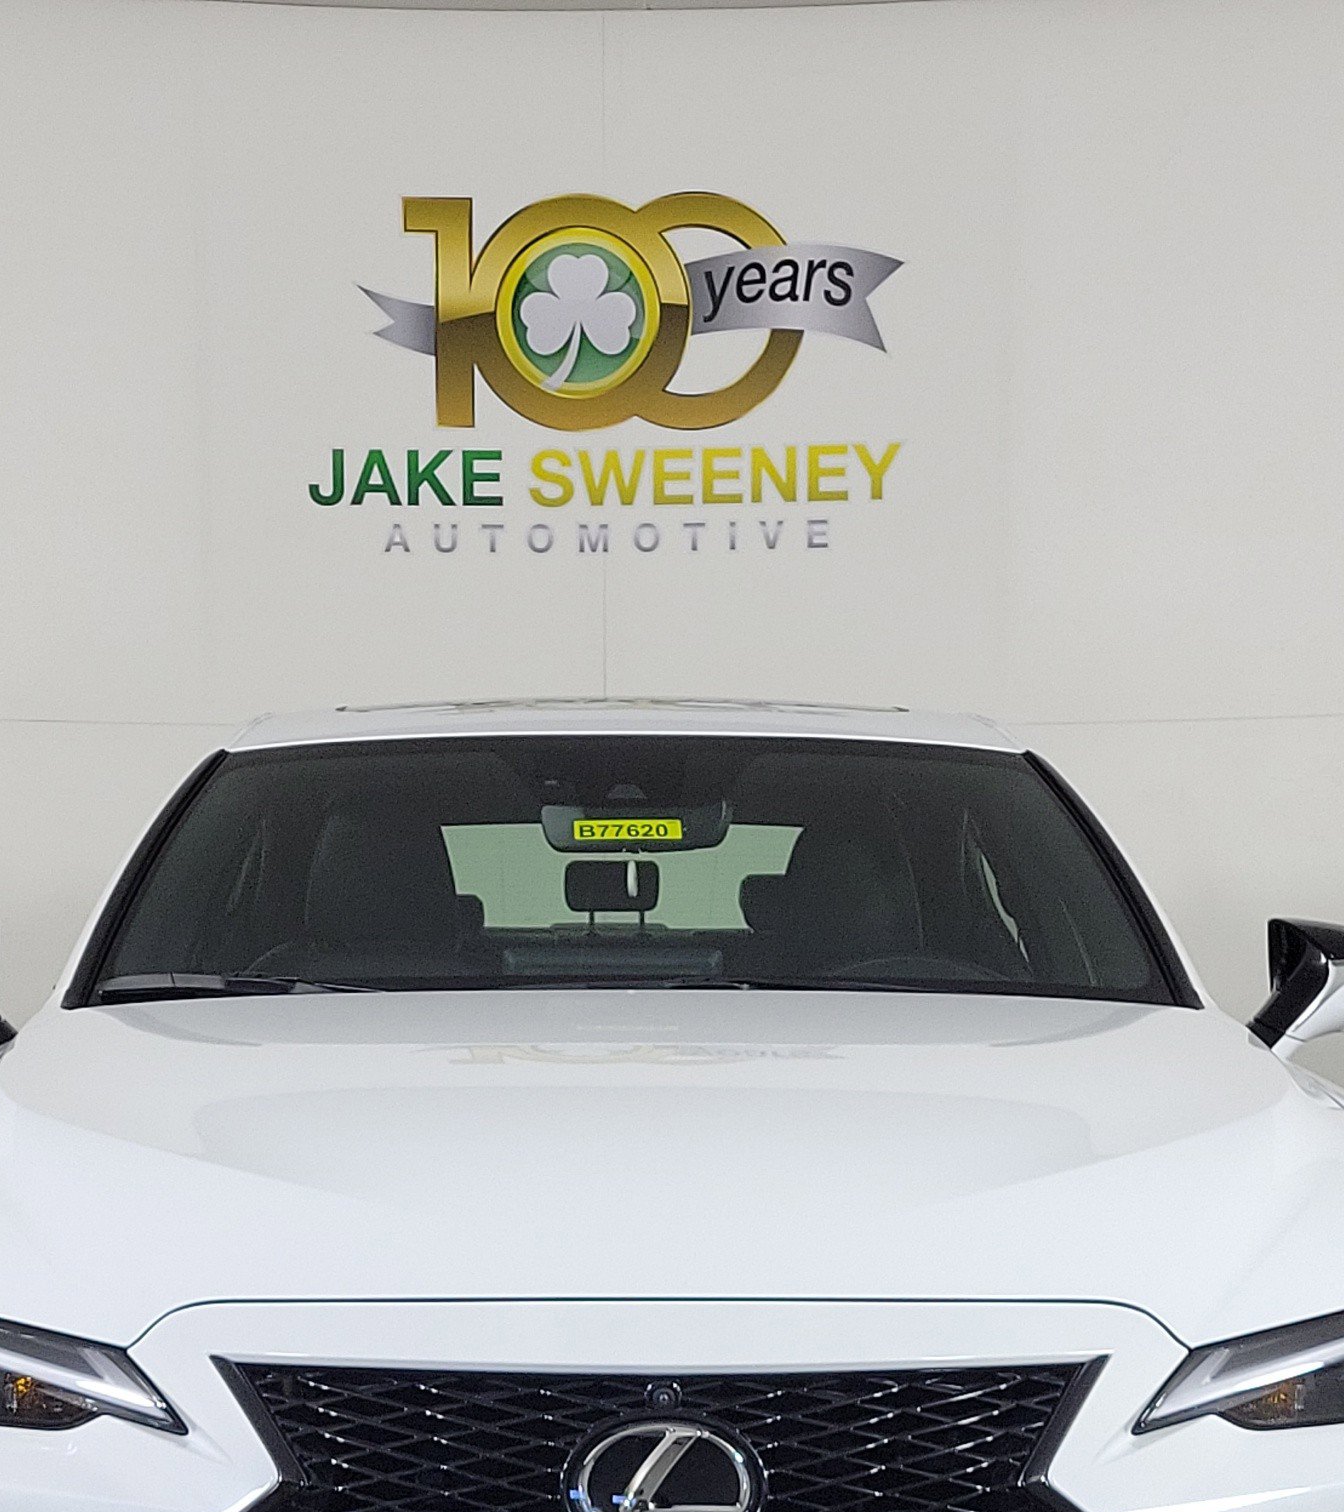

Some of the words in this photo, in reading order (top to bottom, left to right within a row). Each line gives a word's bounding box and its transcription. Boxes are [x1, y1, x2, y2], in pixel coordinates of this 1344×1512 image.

[402, 191, 804, 432] 100
[703, 257, 855, 322] years
[308, 447, 505, 508] JAKE
[528, 442, 902, 508] SWEENEY
[383, 519, 830, 555] AUTOMOTIVE
[579, 824, 668, 838] B77620
